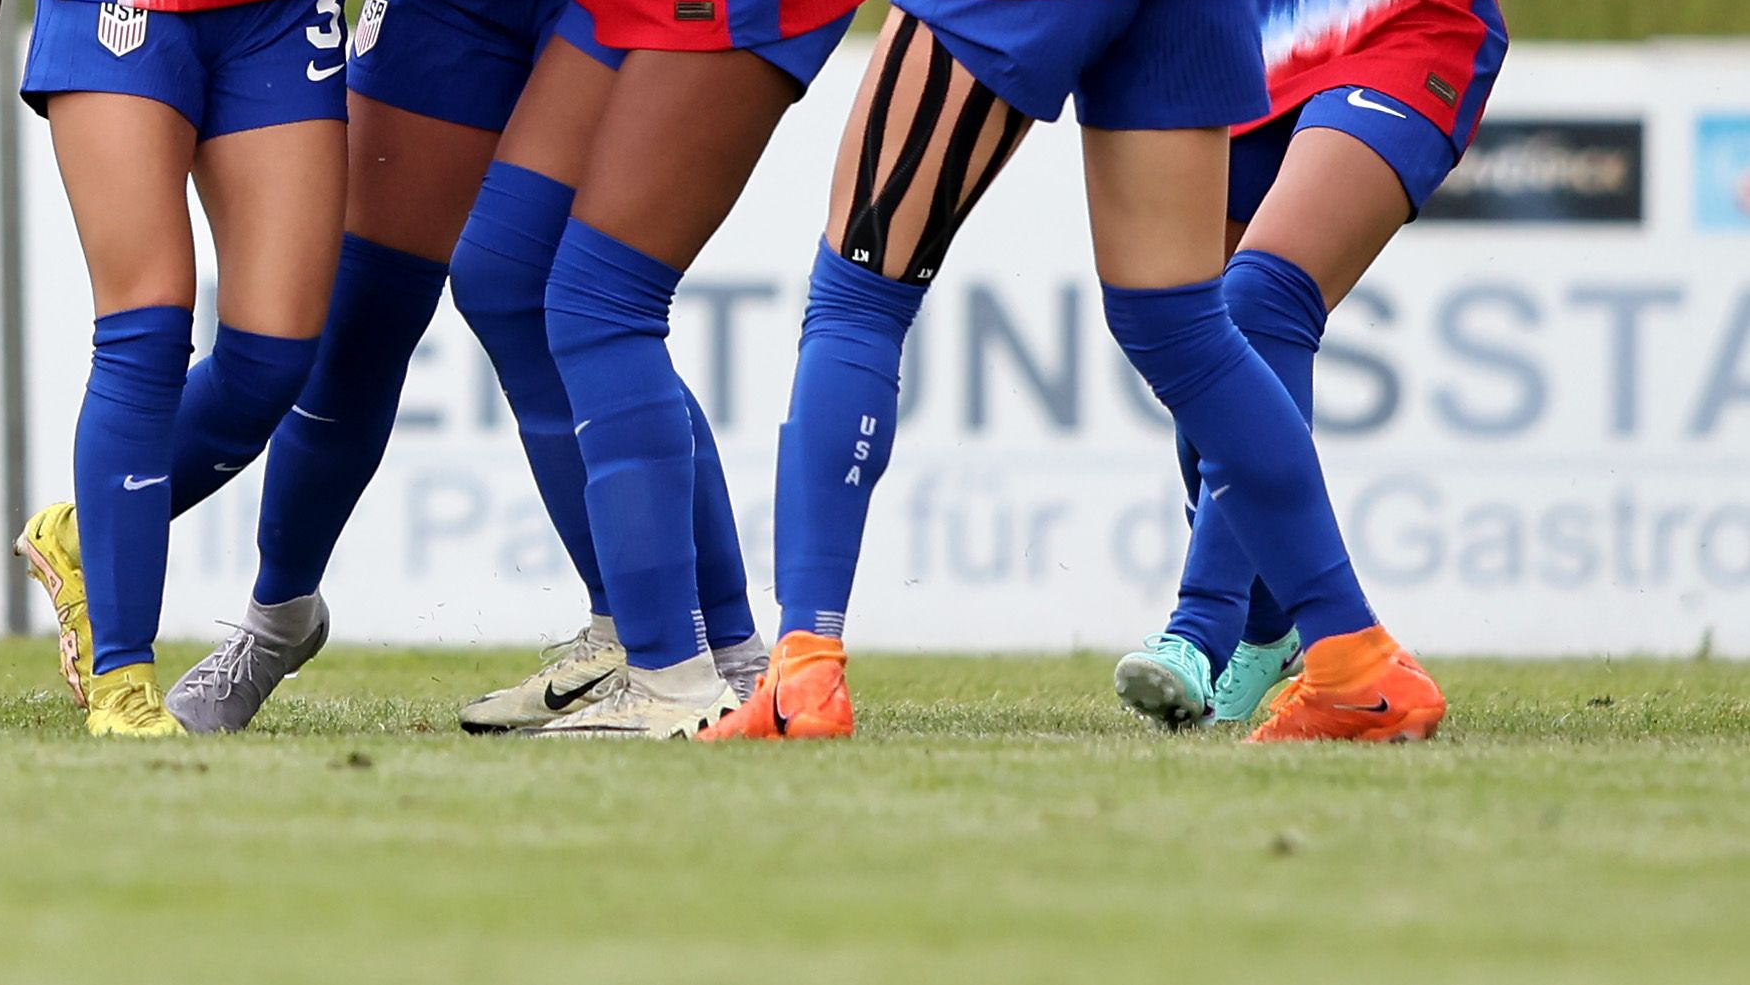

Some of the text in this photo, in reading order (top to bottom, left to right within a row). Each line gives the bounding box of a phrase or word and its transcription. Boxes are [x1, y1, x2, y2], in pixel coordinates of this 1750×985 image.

[363, 0, 386, 22] SA
[852, 248, 869, 263] KT
[845, 415, 877, 487] USA
